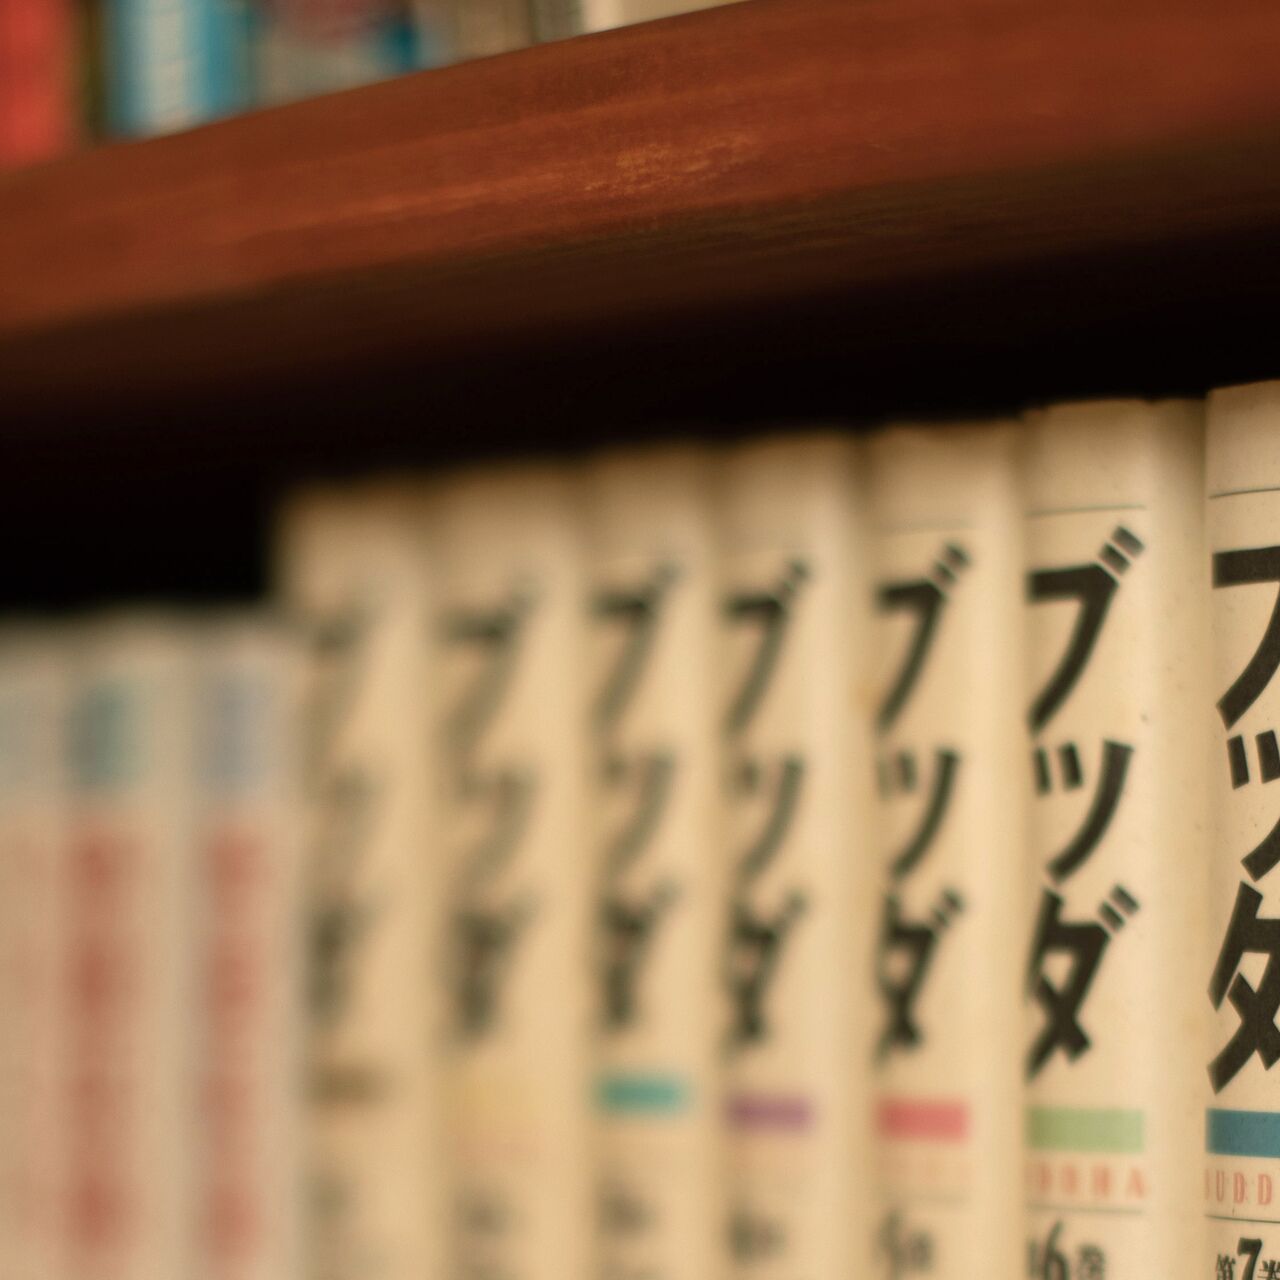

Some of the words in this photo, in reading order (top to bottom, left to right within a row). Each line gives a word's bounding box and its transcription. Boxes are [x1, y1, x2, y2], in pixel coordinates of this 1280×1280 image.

[875, 541, 970, 1066] ブッダ
[1025, 526, 1145, 1084] ブッダ
